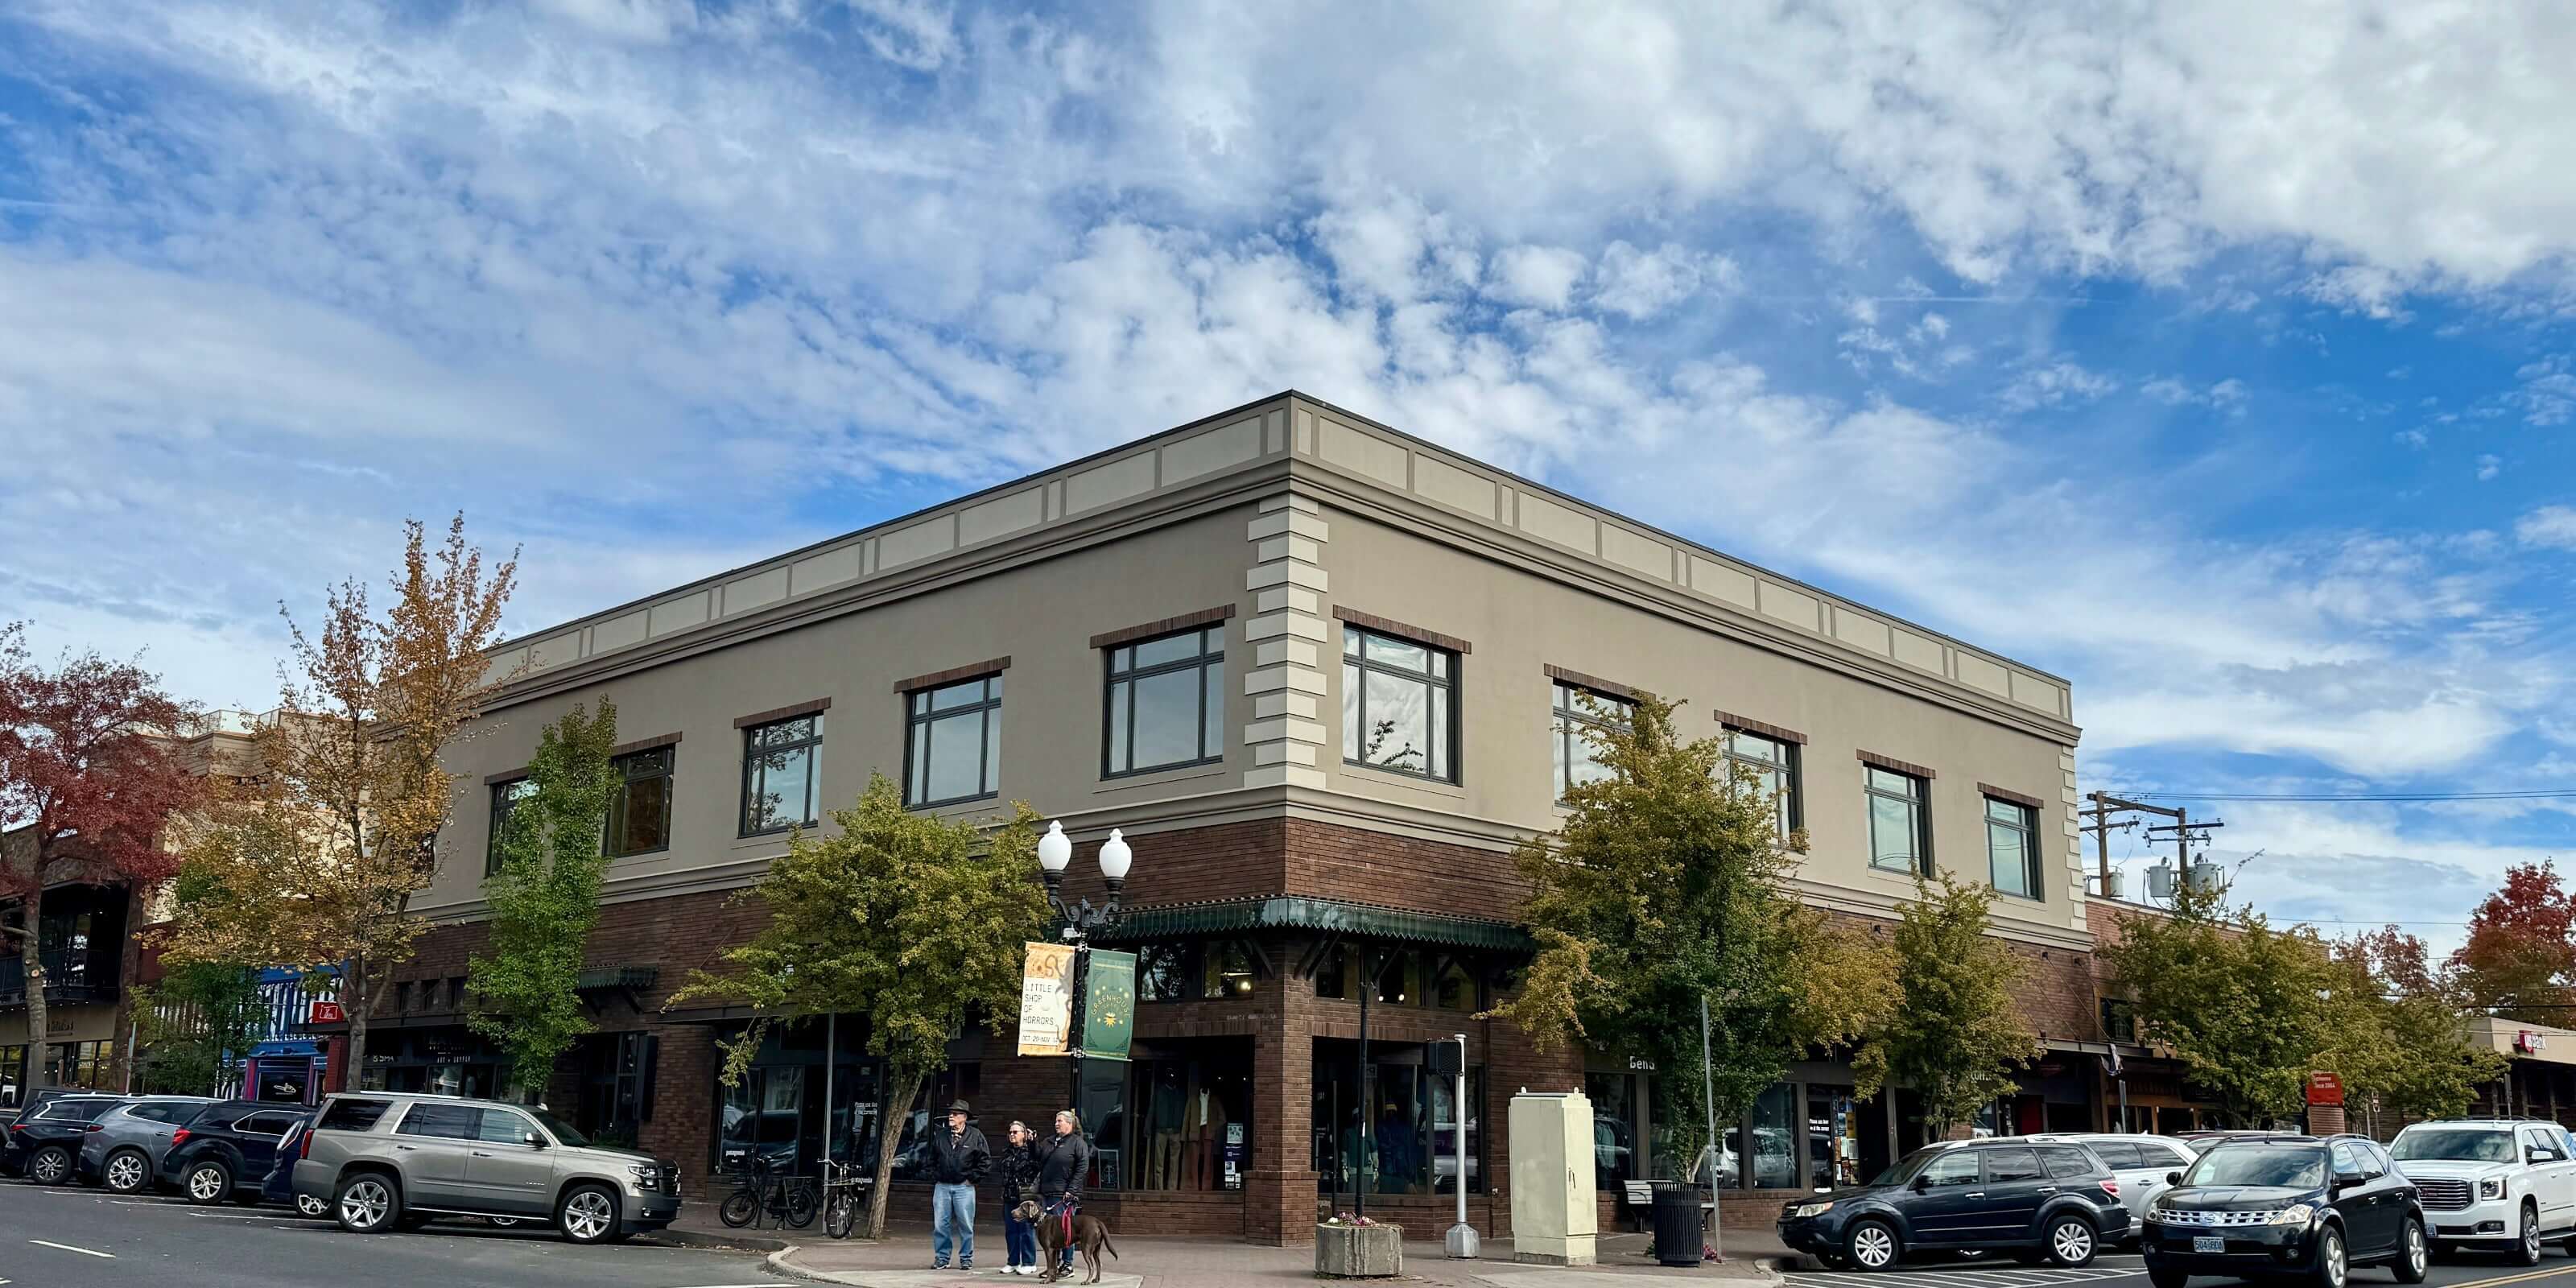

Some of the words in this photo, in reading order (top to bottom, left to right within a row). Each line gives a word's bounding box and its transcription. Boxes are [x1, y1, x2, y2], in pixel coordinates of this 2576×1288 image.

[1025, 983, 1052, 993] LITTLE
[1024, 993, 1042, 1002] SHOP
[1023, 1005, 1033, 1013] OF
[1091, 993, 1130, 1018] GREENHOUSE
[1022, 1017, 1055, 1026] HORRORS
